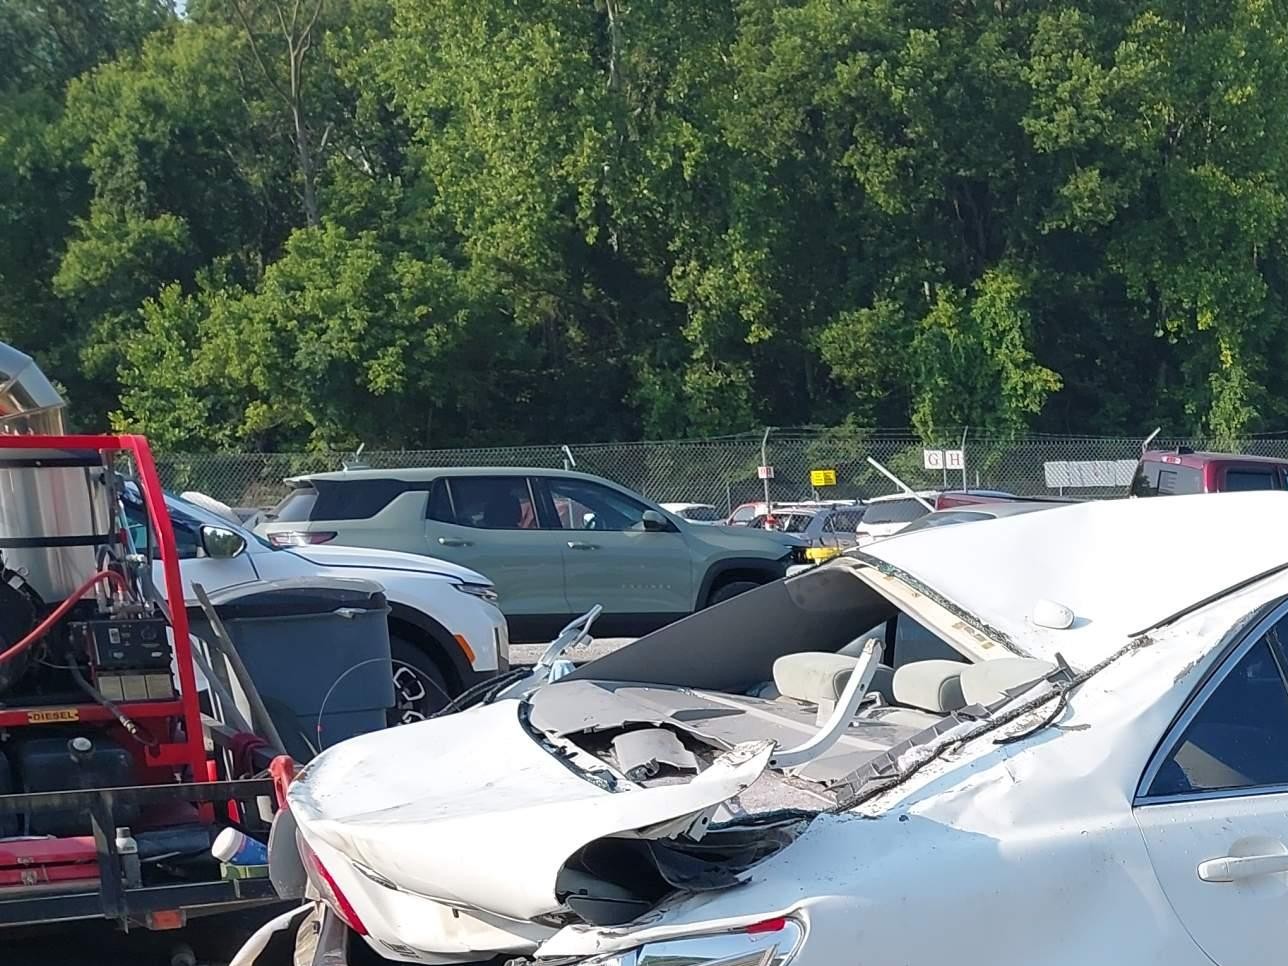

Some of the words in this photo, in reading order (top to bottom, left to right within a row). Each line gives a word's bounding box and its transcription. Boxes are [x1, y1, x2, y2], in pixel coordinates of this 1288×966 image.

[928, 452, 939, 466] G
[950, 453, 961, 466] H
[33, 711, 75, 720] DIESEL
